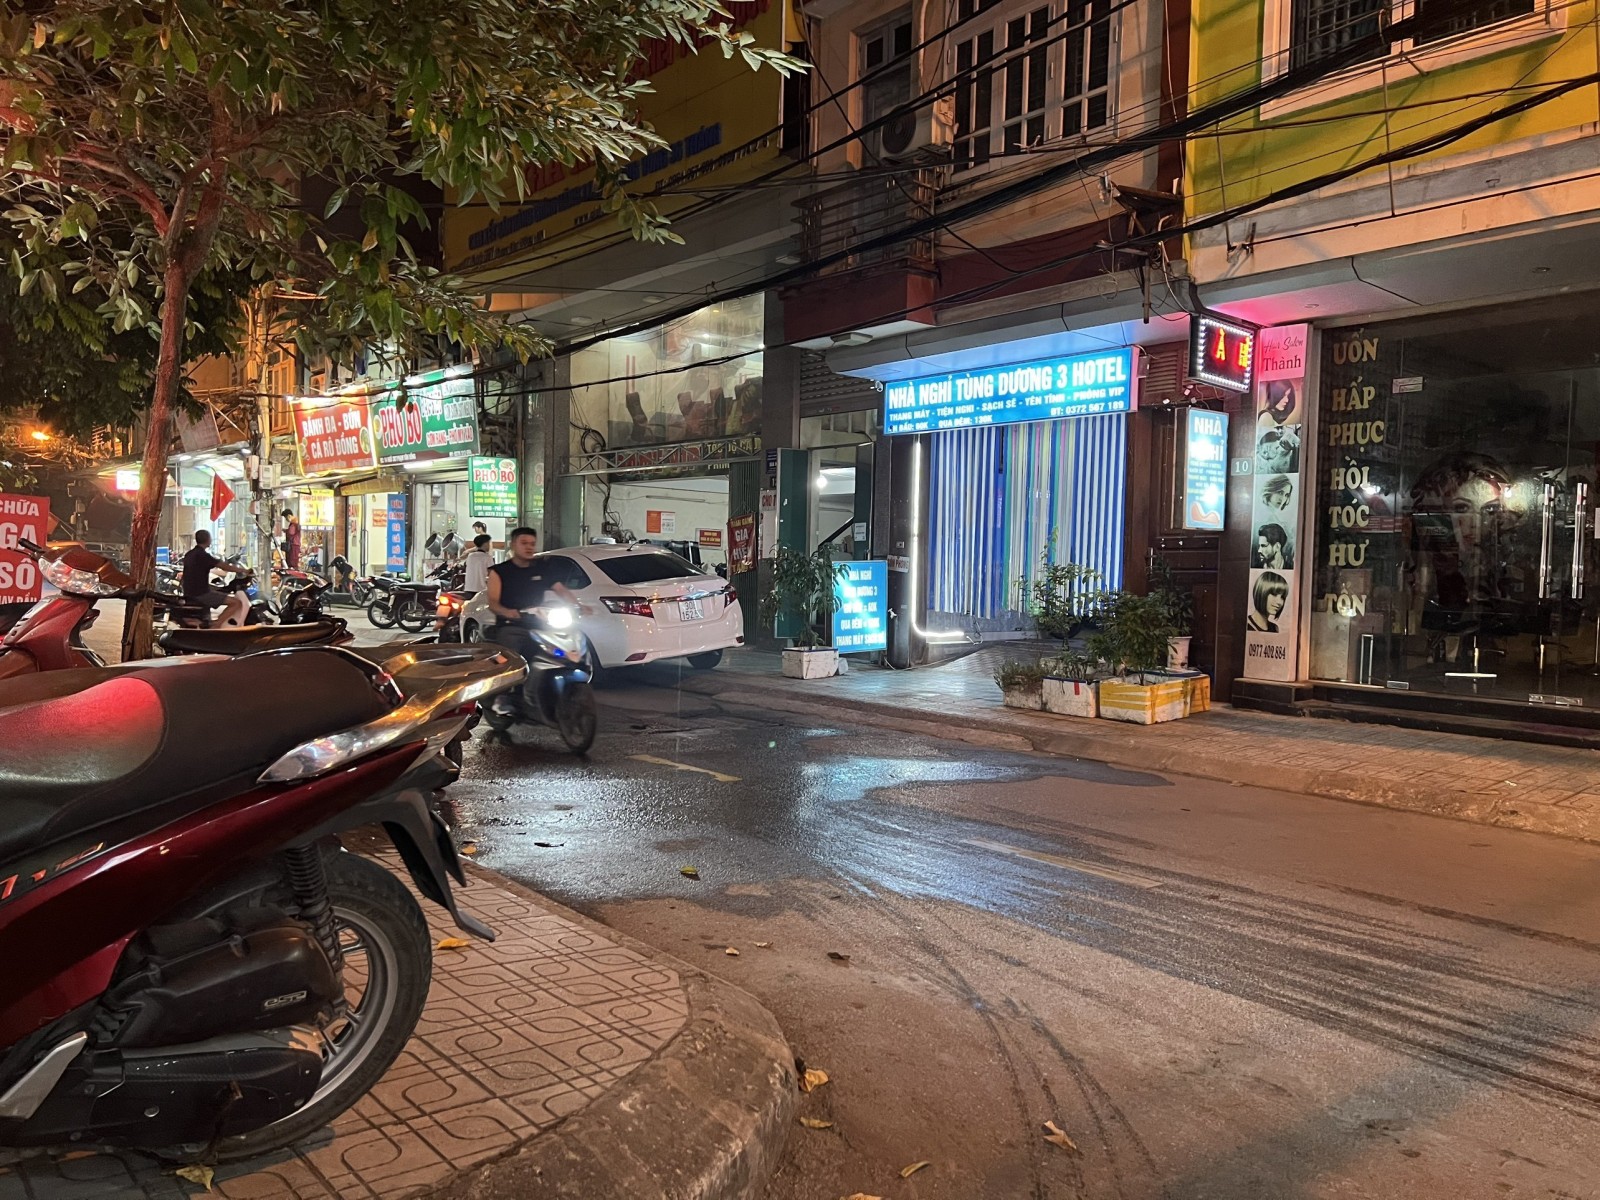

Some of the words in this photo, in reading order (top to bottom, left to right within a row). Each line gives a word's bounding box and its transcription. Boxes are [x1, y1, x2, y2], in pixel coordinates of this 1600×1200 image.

[1333, 328, 1379, 365] UỐN
[1263, 354, 1301, 372] Thành
[888, 381, 916, 410] NHÀ
[919, 375, 952, 406] NGHỈ
[955, 373, 994, 401] TÙNG
[1056, 364, 1068, 388] 3
[1072, 356, 1126, 387] HOTEL
[1332, 376, 1376, 412] HẤP
[889, 411, 913, 422] THANG
[981, 400, 1004, 412] SẠCH
[1108, 386, 1125, 397] VIP
[1194, 416, 1222, 437] NHÀ
[1328, 420, 1385, 453] PHỤC
[1234, 460, 1249, 473] 10
[1330, 455, 1371, 491] HỒI
[0, 499, 40, 517] HỮA
[1328, 498, 1370, 528] TÓC
[1328, 539, 1370, 567] HƯ
[1249, 643, 1263, 657] 0977
